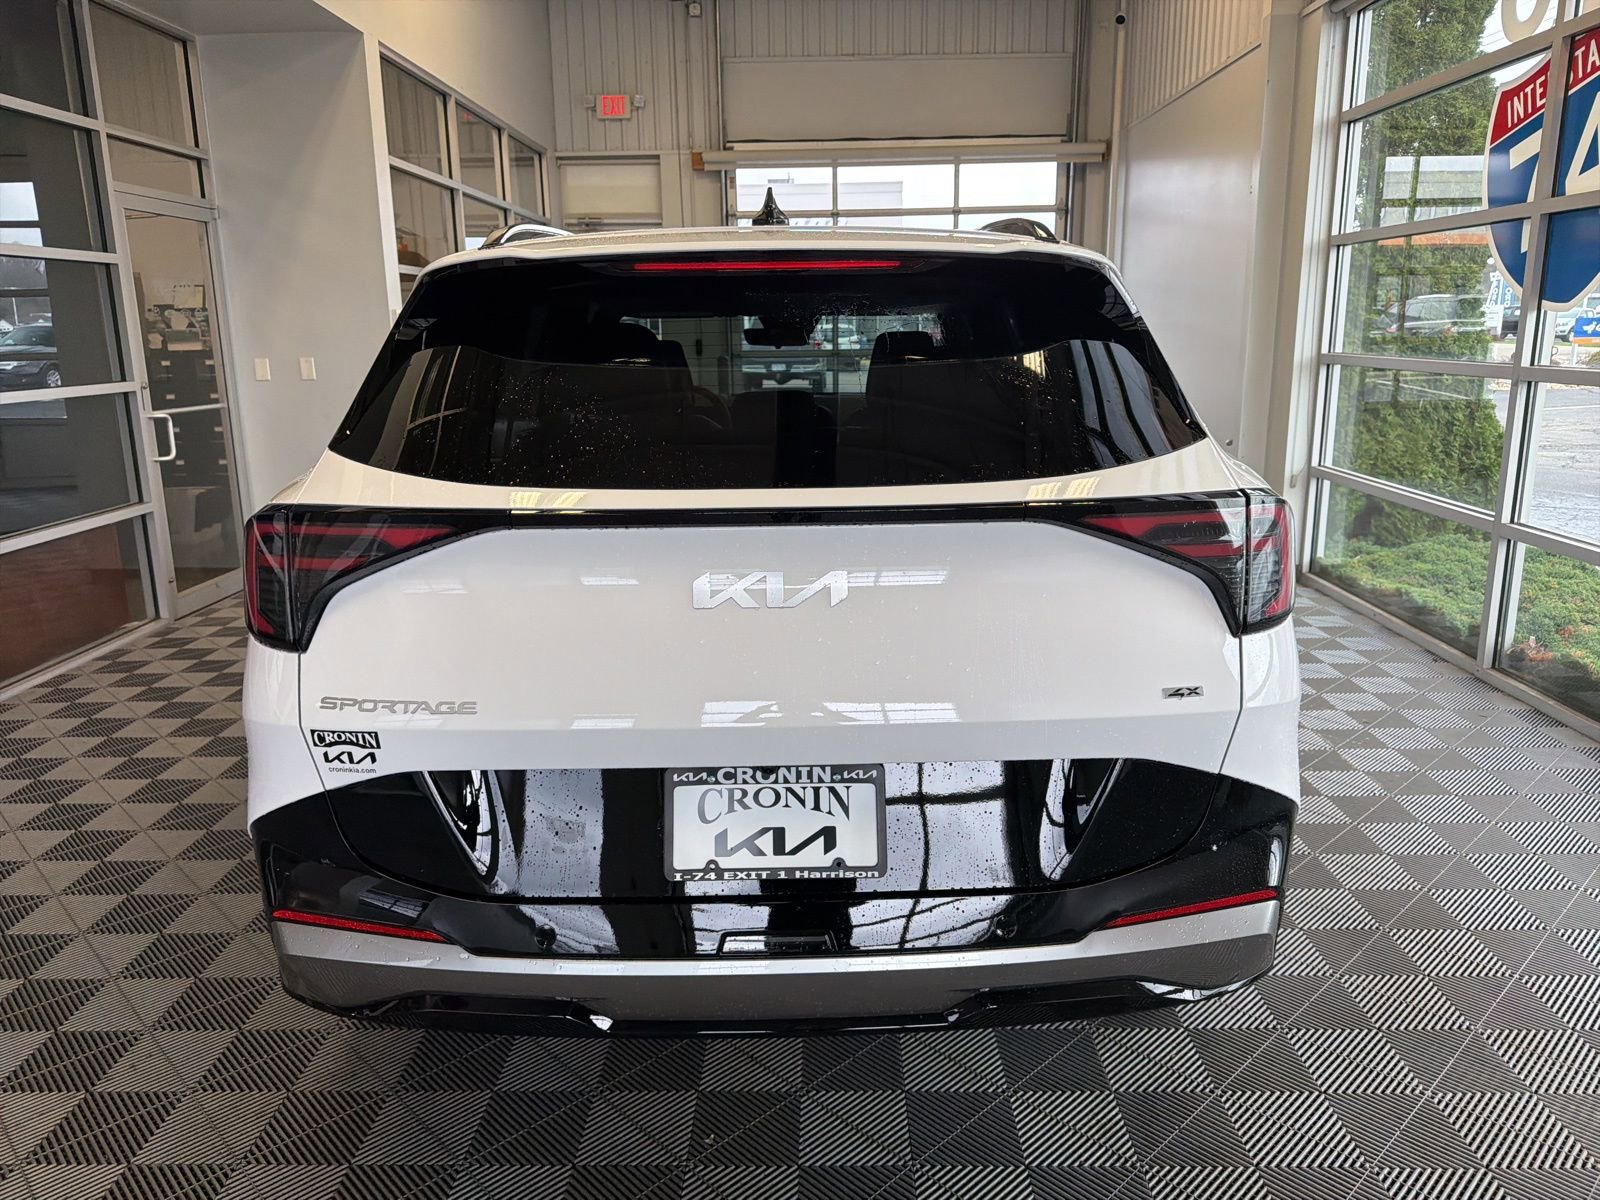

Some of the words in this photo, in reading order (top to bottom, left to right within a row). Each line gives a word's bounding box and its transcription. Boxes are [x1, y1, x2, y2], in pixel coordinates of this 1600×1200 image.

[1507, 39, 1600, 128] INTETA
[601, 95, 625, 116] EXIT
[692, 570, 849, 609] KIA
[319, 695, 478, 715] SPORTAGE
[313, 731, 378, 749] CRONIN
[322, 750, 378, 765] KIA
[328, 766, 377, 775] croninkia.com
[673, 772, 707, 782] KIA
[716, 766, 832, 784] CRONIN
[843, 769, 878, 780] KIA
[697, 785, 852, 825] CRONIN
[714, 825, 837, 857] KIA
[673, 870, 717, 881] I-74
[723, 870, 771, 880] EXIT
[777, 870, 788, 879] 1
[794, 869, 879, 879] Harrison
